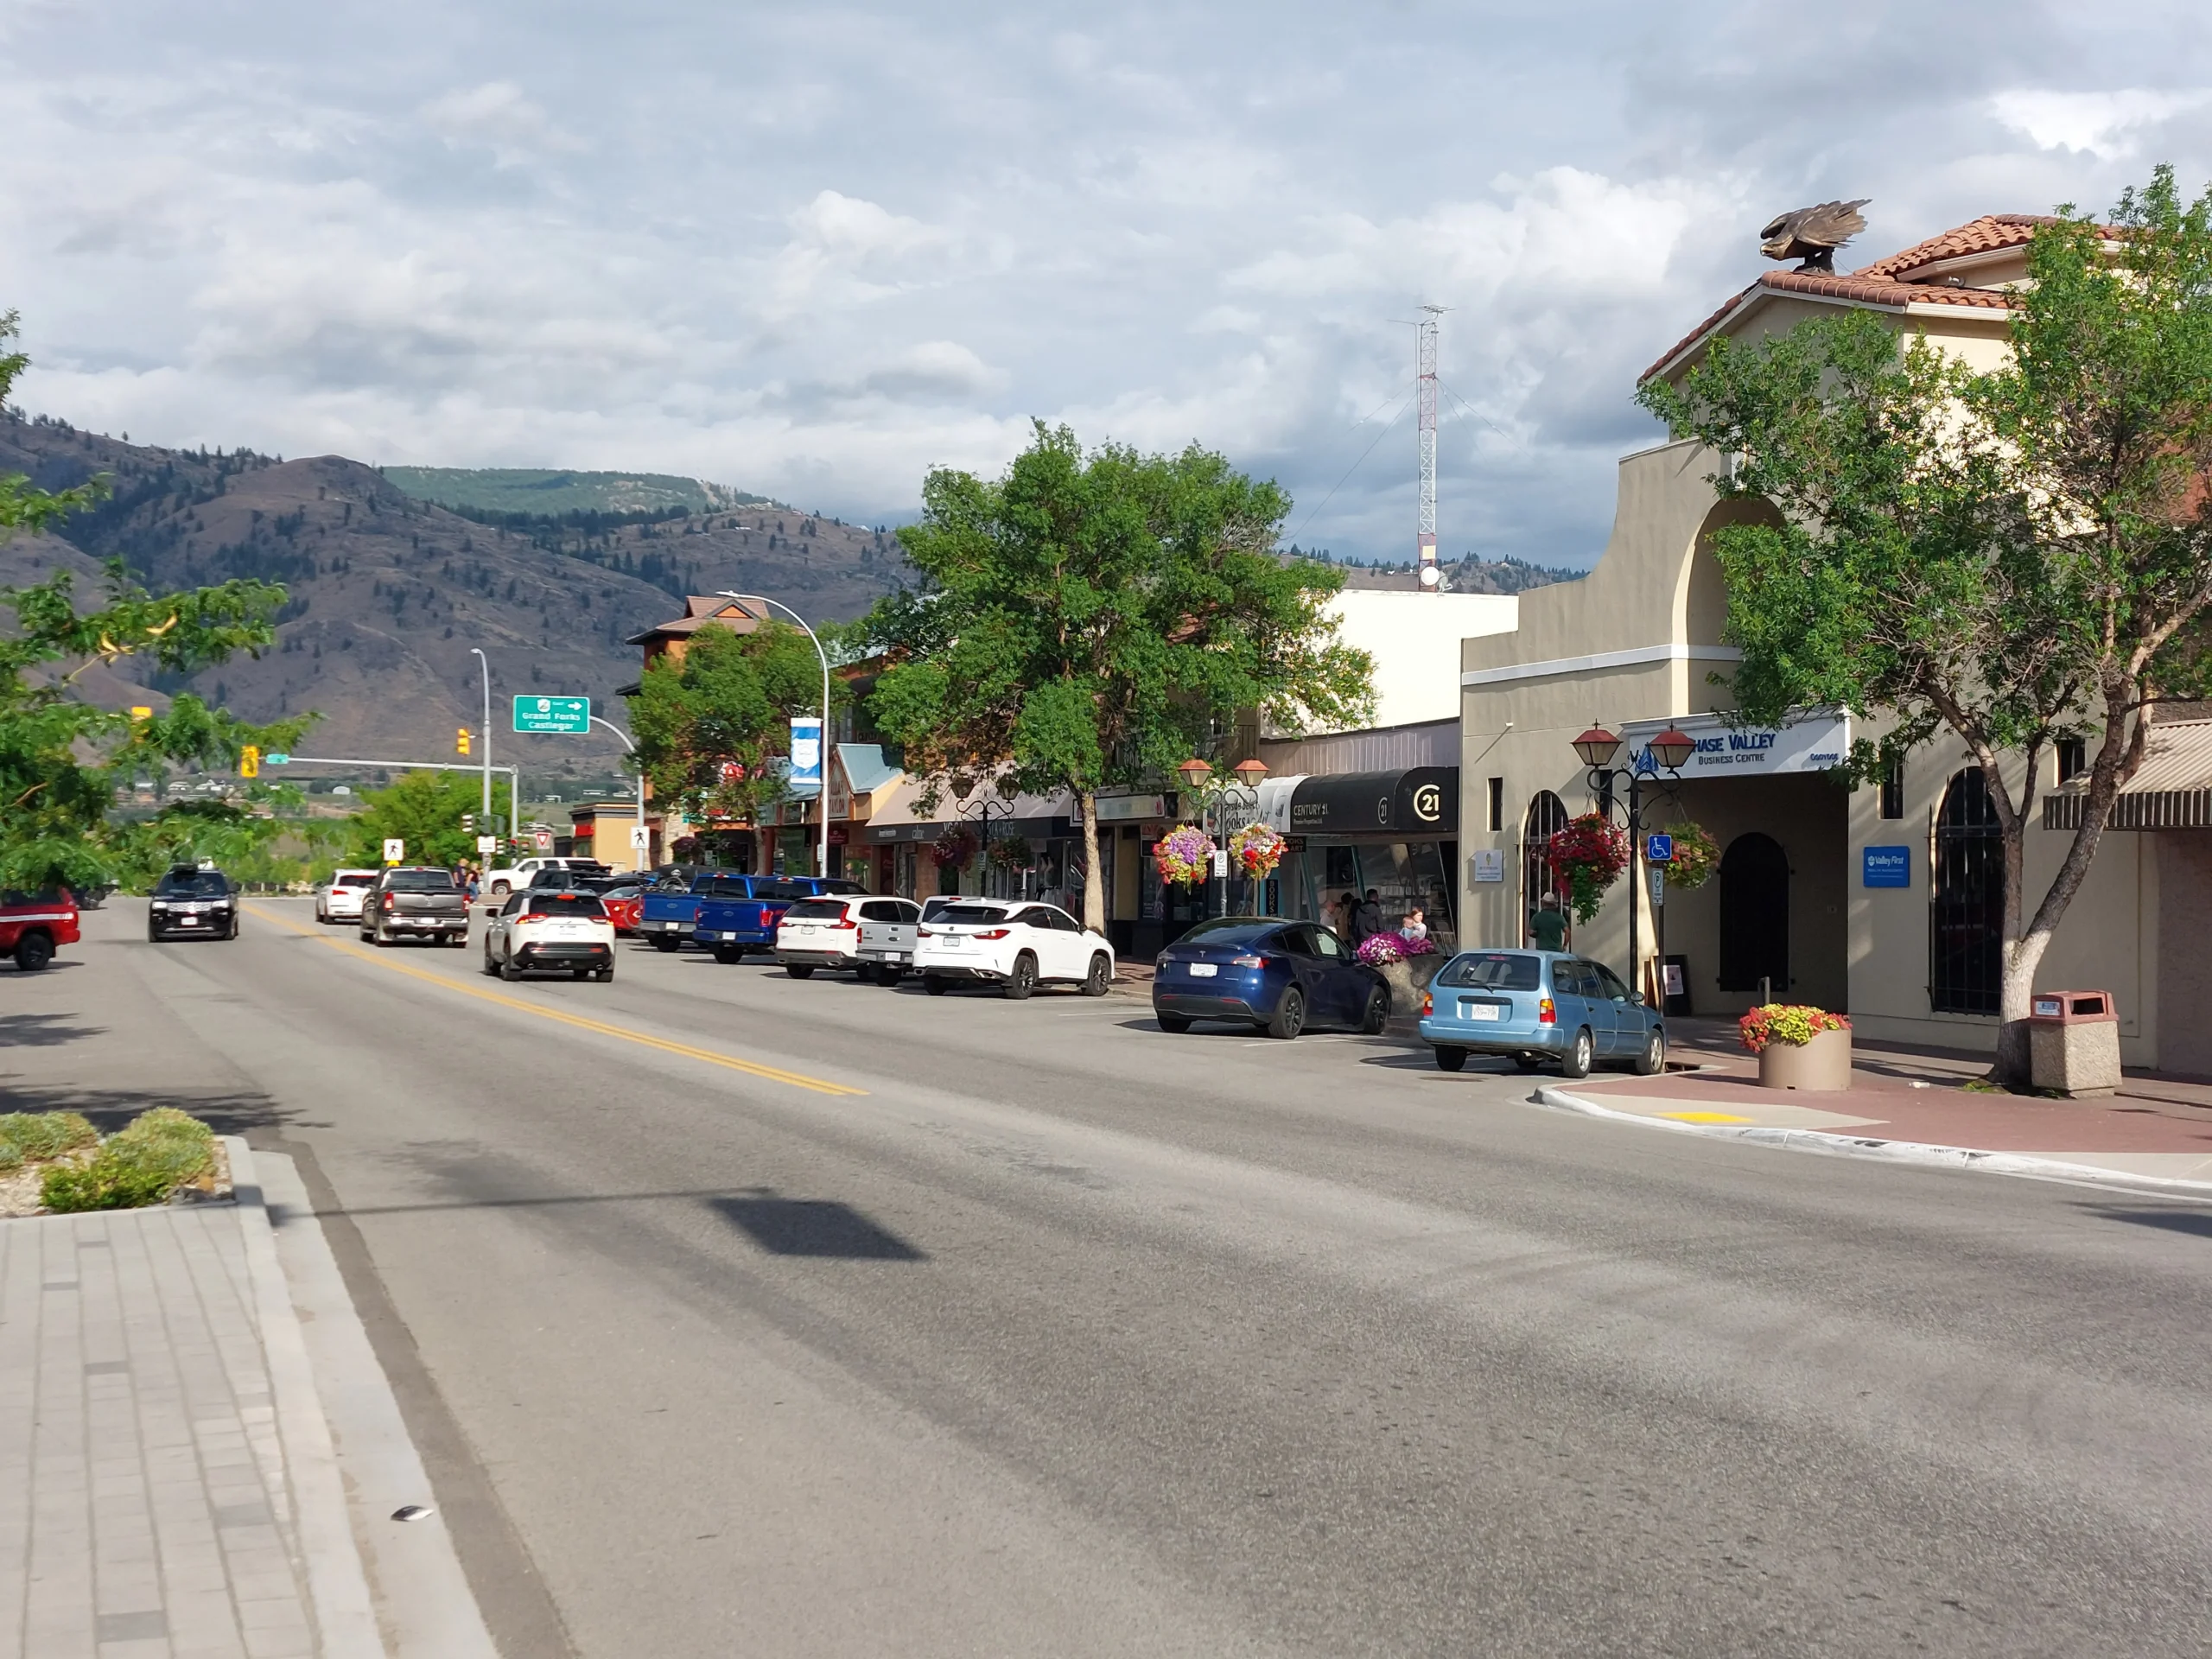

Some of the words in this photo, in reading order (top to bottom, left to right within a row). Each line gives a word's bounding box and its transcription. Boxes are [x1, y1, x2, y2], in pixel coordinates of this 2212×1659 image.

[528, 721, 575, 731] Castlegar
[1693, 737, 1725, 753] HASE
[1729, 733, 1777, 751] VALLEY
[1699, 754, 1734, 766] BUSINESS
[1736, 753, 1765, 764] CENTRE
[1294, 804, 1321, 816] CENTURY
[1875, 855, 1891, 867] Valley
[1891, 855, 1904, 864] First
